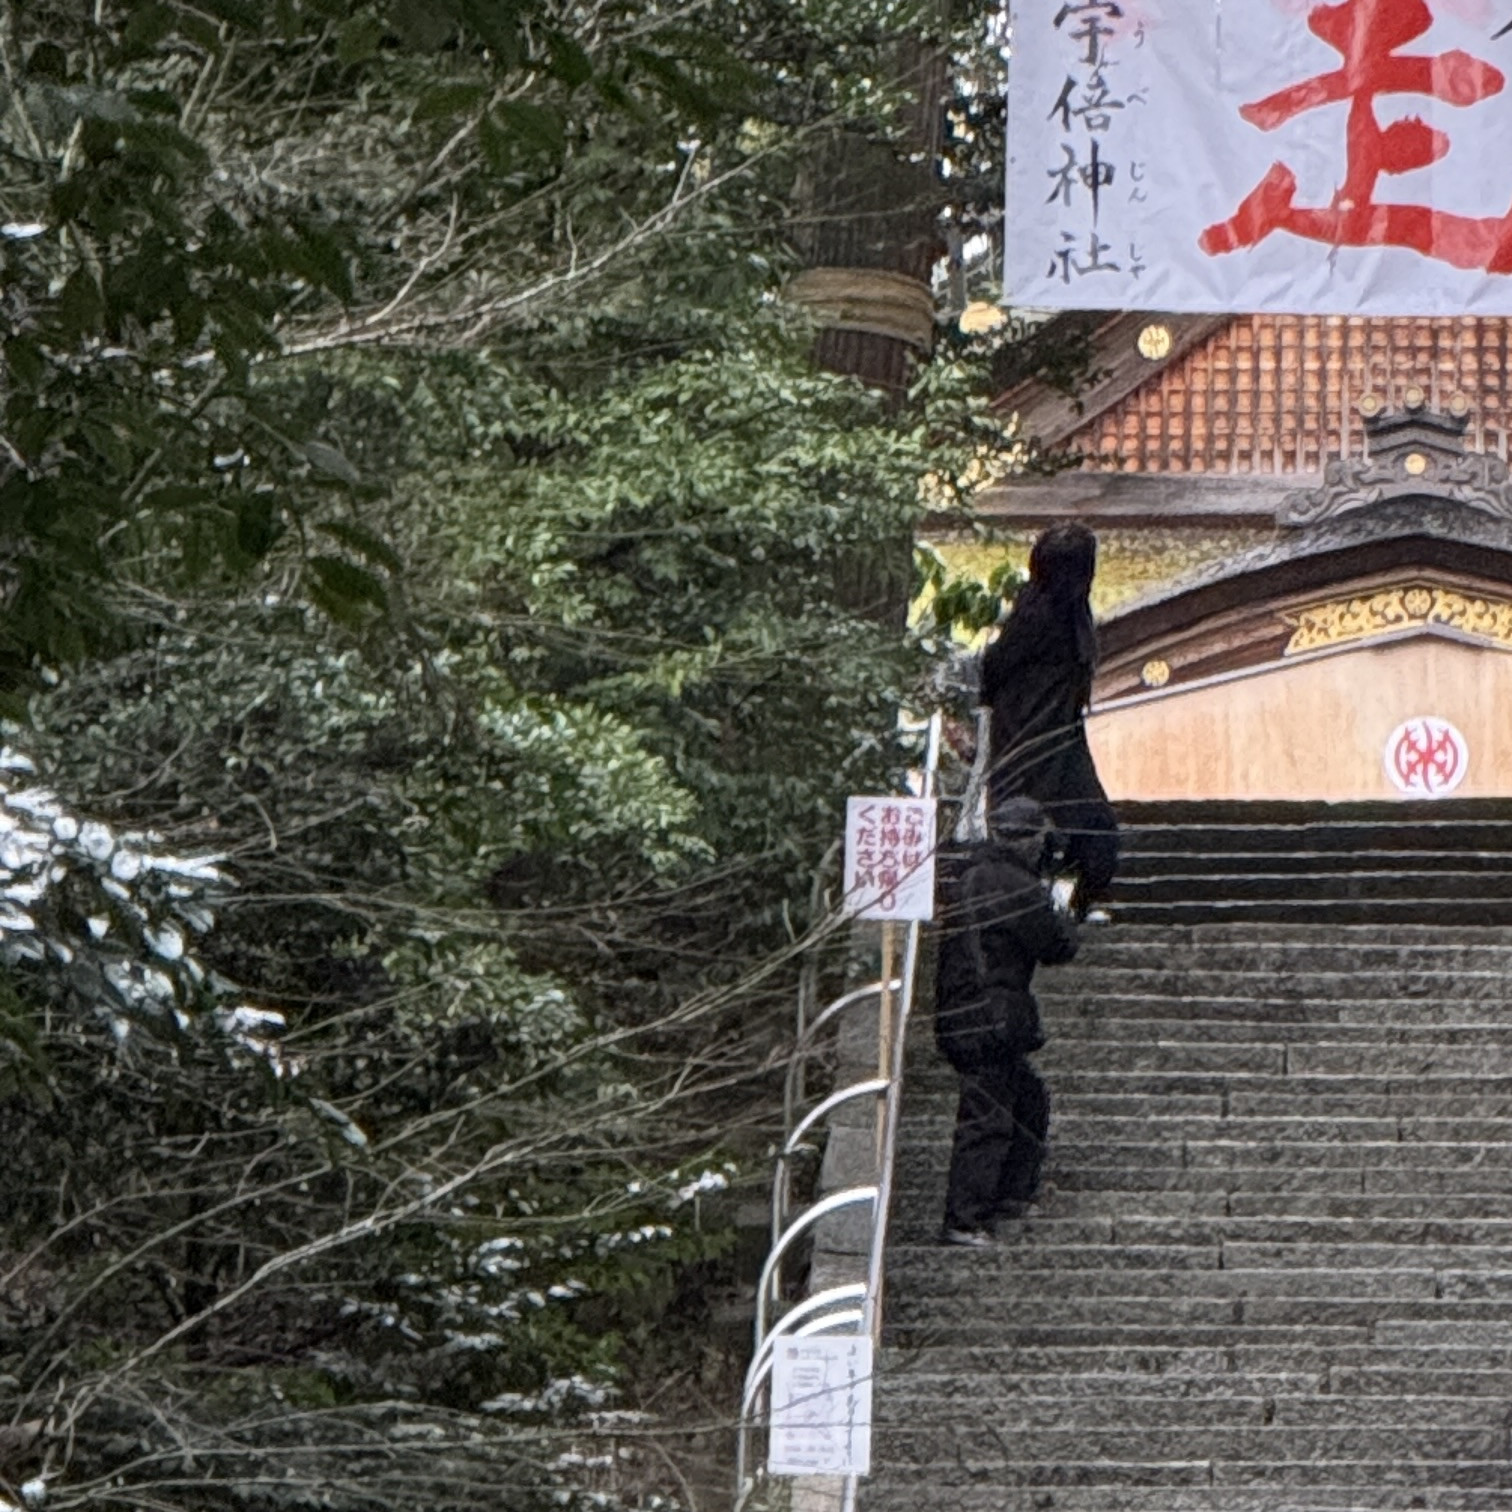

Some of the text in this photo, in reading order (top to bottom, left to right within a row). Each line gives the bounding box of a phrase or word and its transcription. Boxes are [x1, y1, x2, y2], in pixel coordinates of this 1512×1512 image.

[878, 806, 900, 911] お持ち帰り
